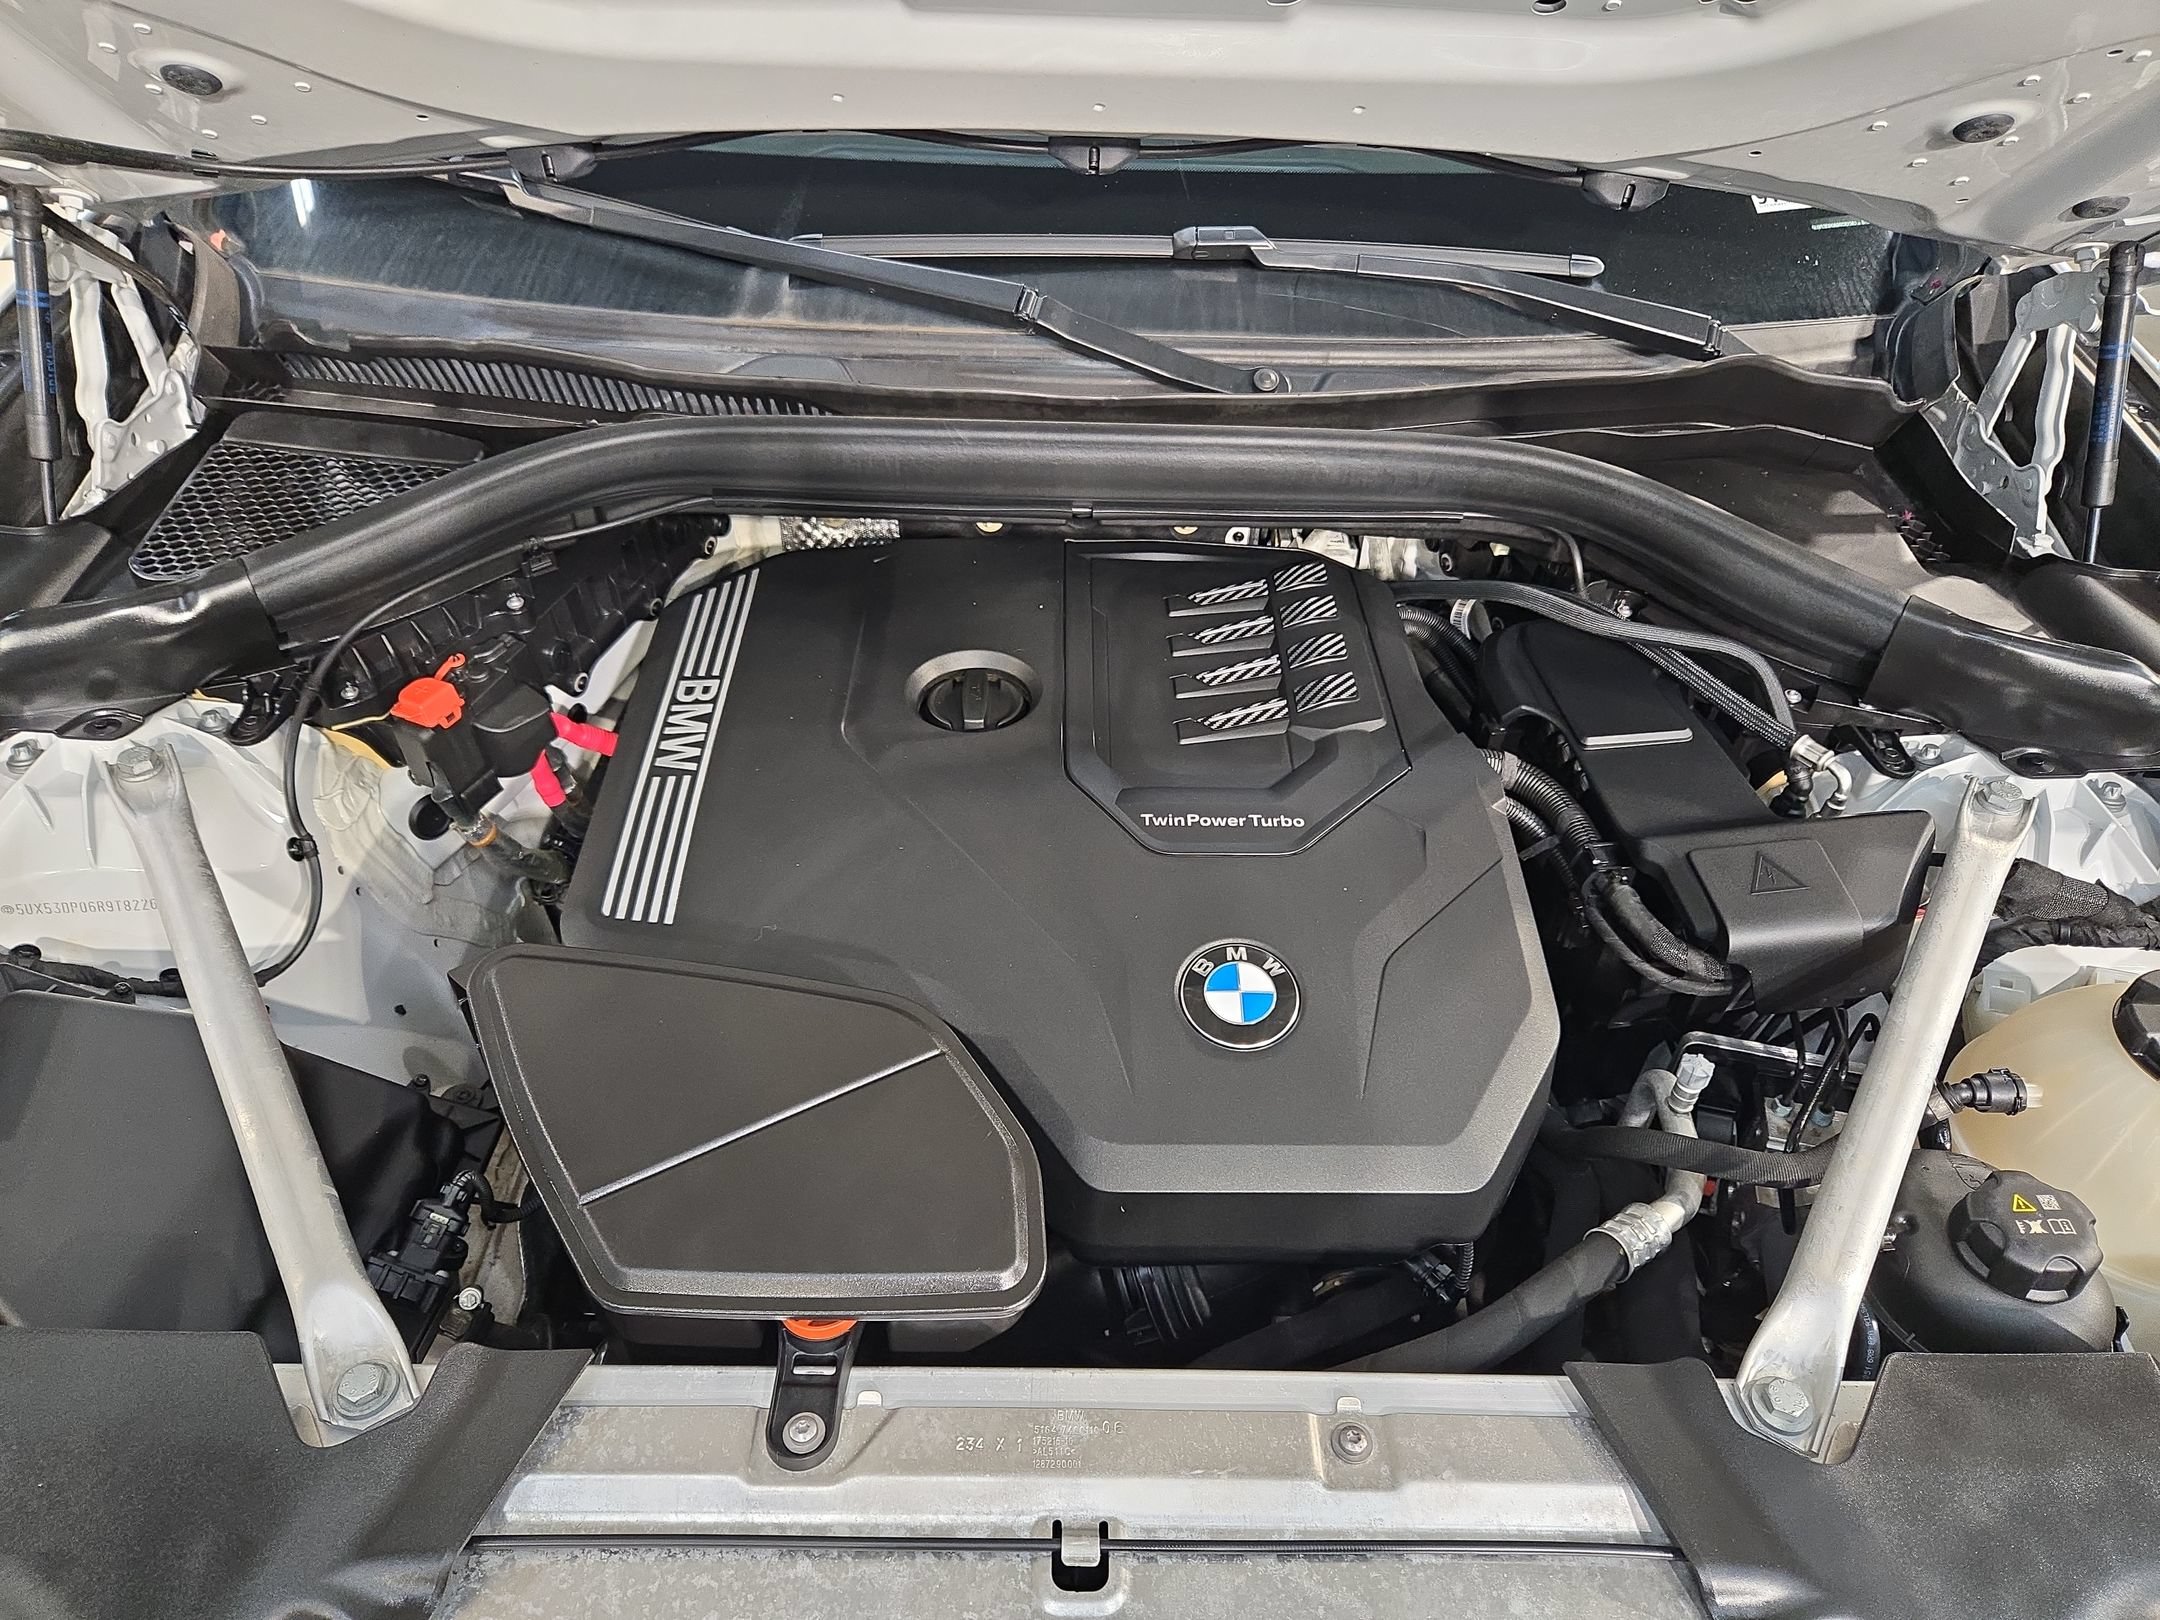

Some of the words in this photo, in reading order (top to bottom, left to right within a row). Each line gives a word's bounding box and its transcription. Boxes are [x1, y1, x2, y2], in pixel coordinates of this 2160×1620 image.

[654, 679, 721, 771] BMW
[1140, 813, 1246, 827] TwinPower
[1248, 814, 1305, 828] Turbo
[1191, 946, 1286, 977] BMW
[1057, 1409, 1085, 1421] BMW
[955, 1437, 985, 1451] 234
